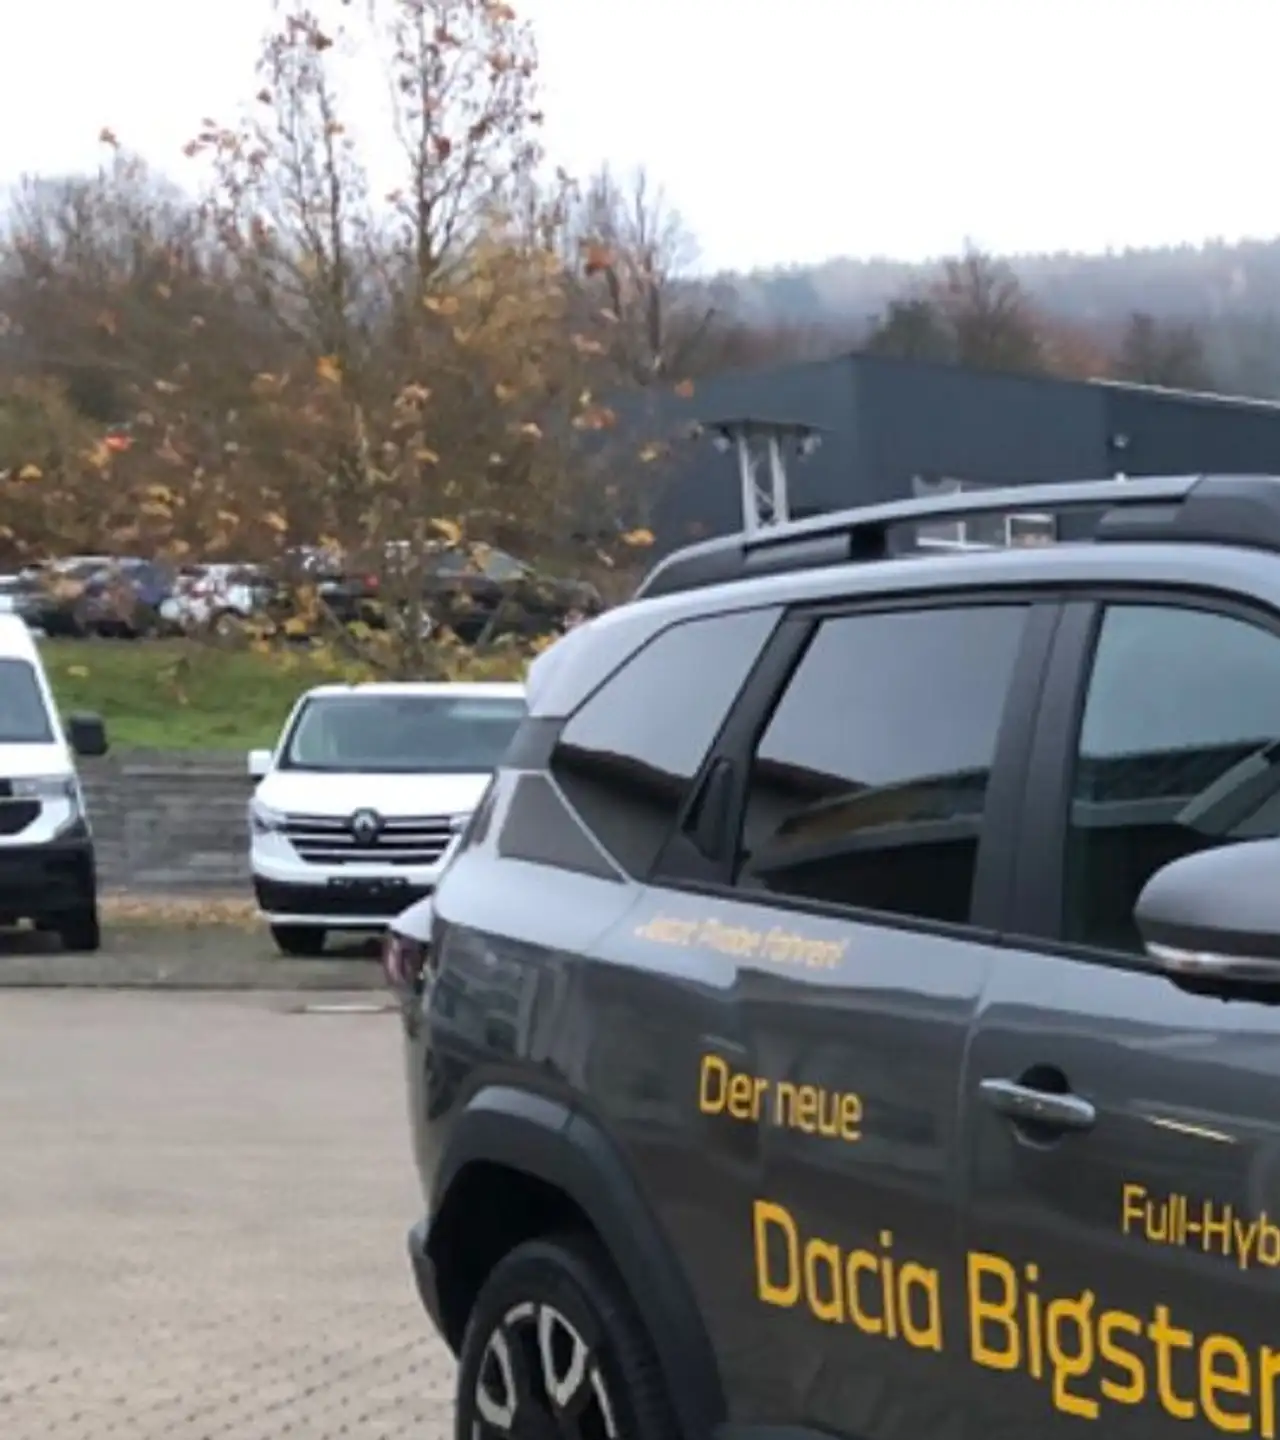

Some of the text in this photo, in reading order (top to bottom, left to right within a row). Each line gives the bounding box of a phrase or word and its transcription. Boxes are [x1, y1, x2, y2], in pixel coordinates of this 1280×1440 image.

[699, 1054, 862, 1141] Der neue
[753, 1200, 943, 1352] Dacia
